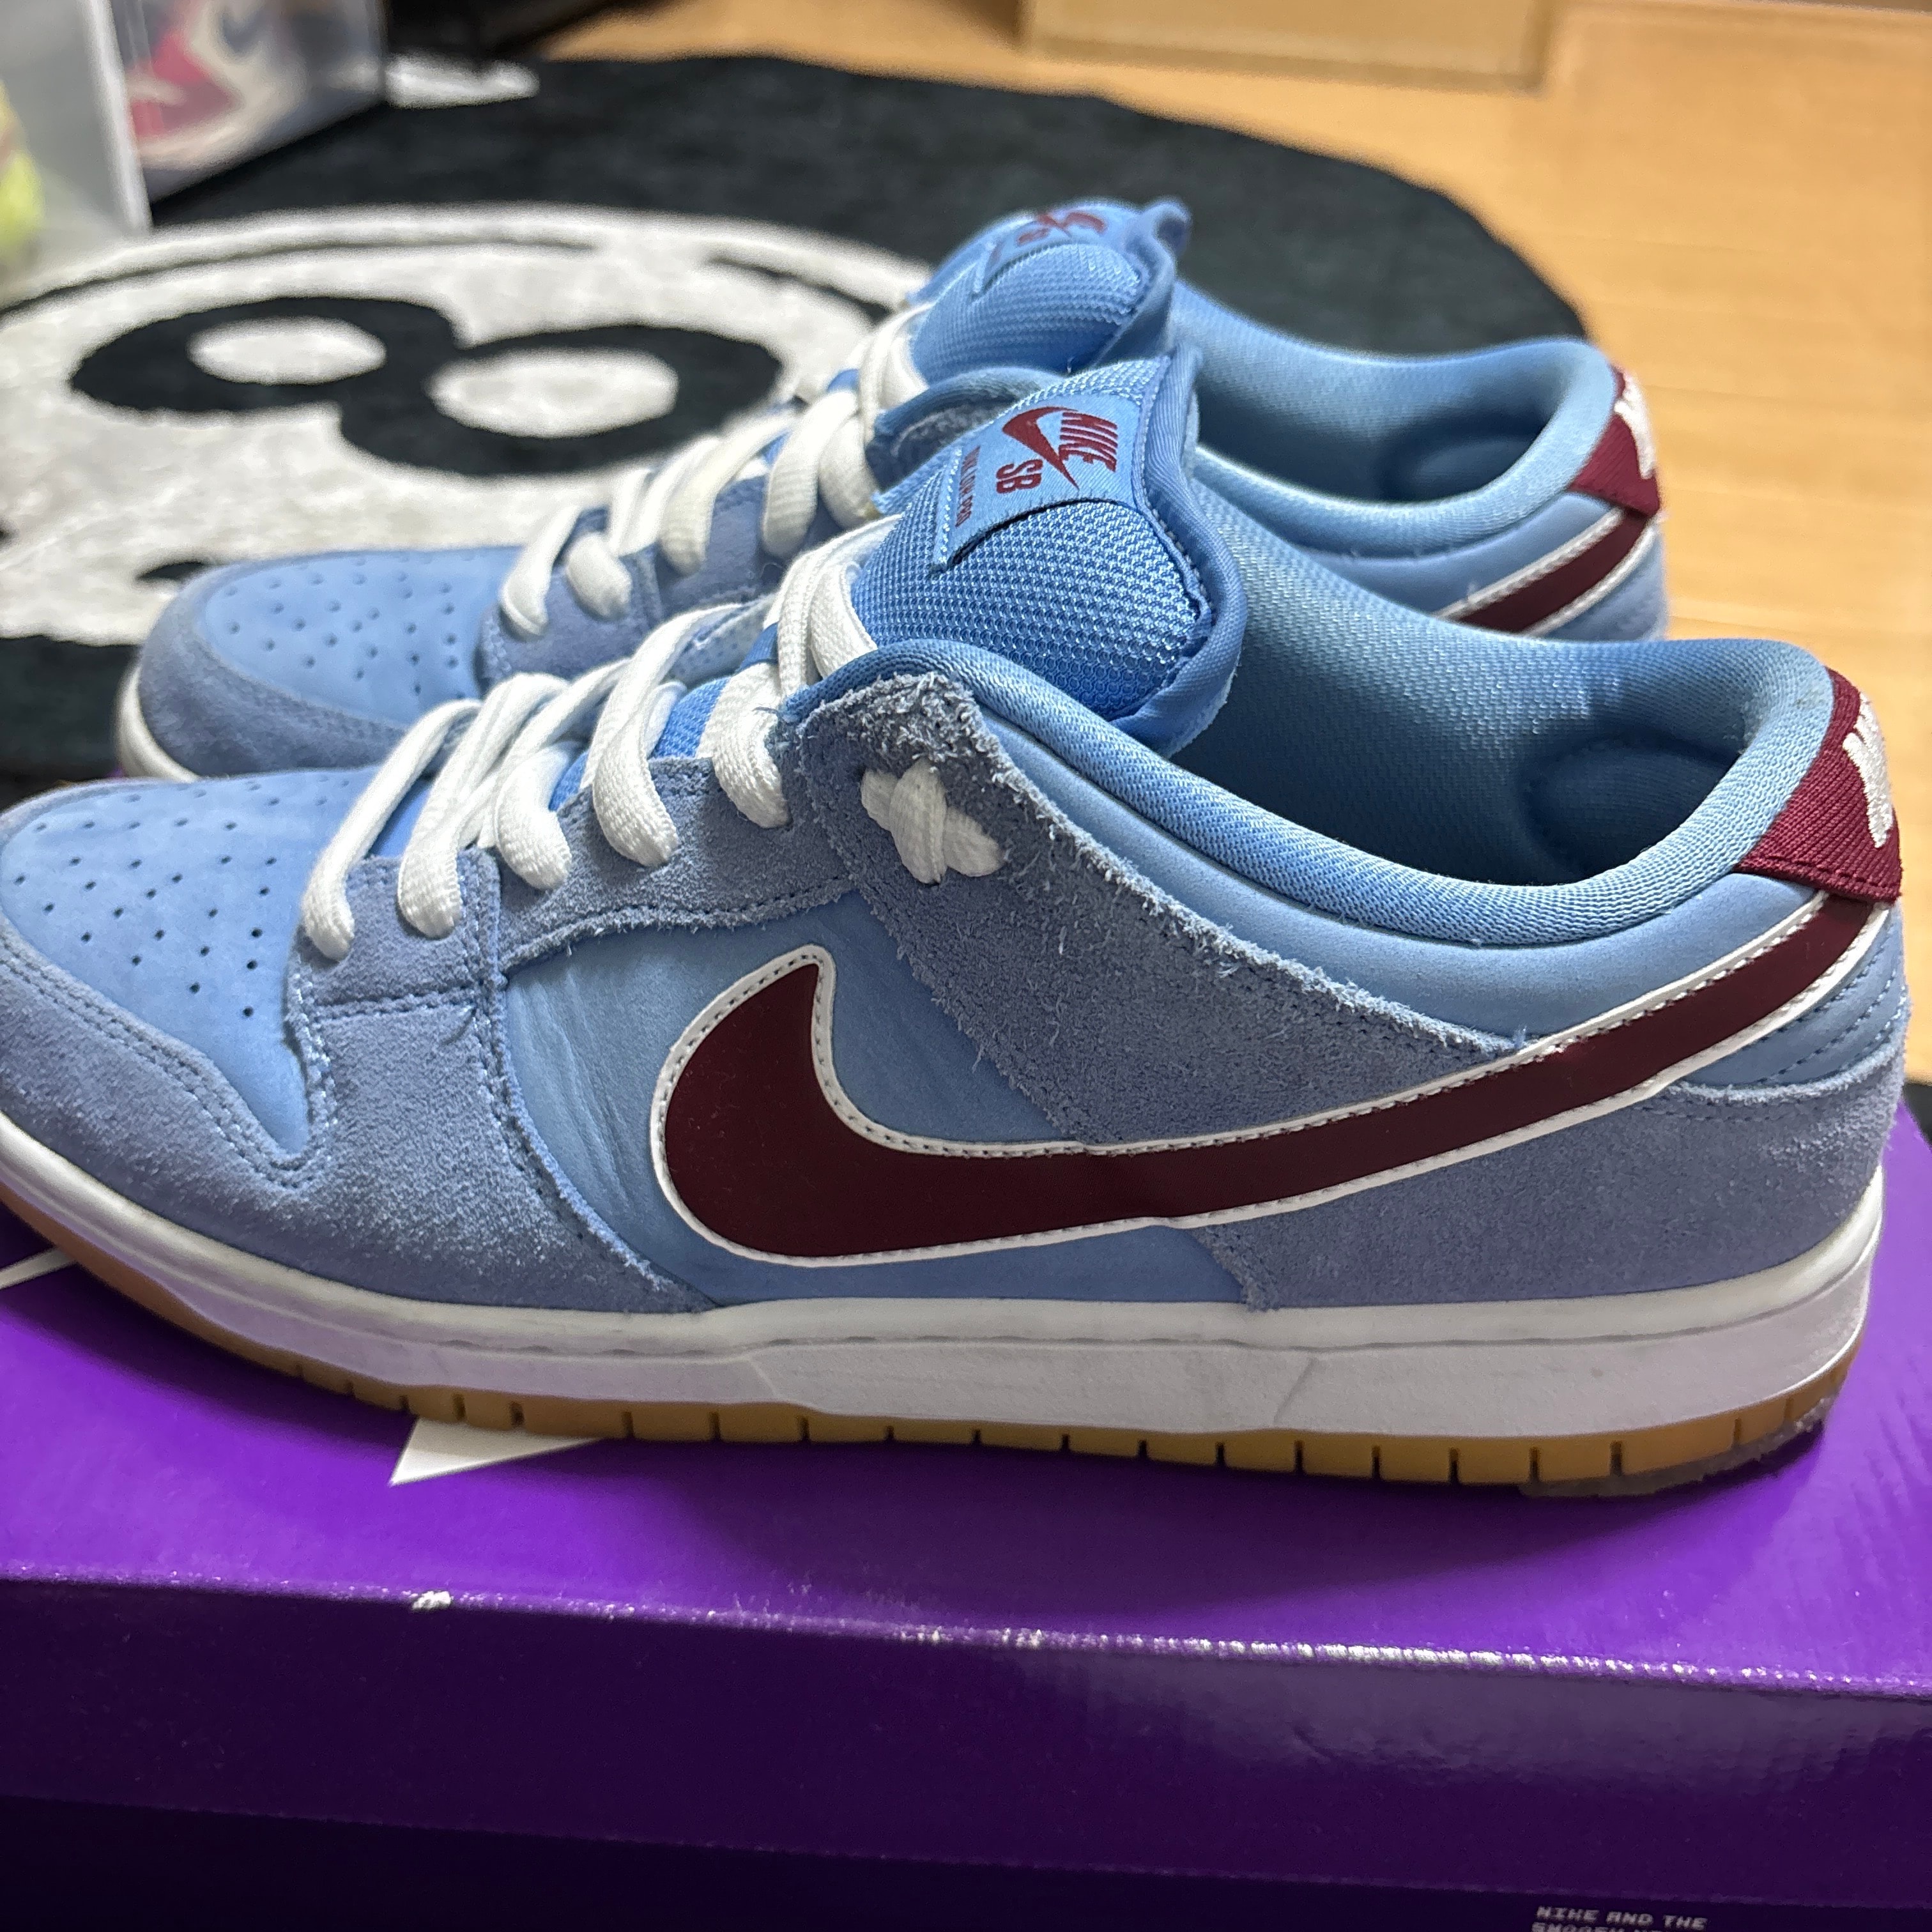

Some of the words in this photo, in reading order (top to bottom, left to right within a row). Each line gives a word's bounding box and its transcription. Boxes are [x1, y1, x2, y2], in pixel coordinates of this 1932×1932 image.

[1059, 411, 1119, 473] NIKE
[995, 459, 1043, 494] SB
[1606, 1912, 1653, 1926] AND
[1663, 1915, 1708, 1931] THE
